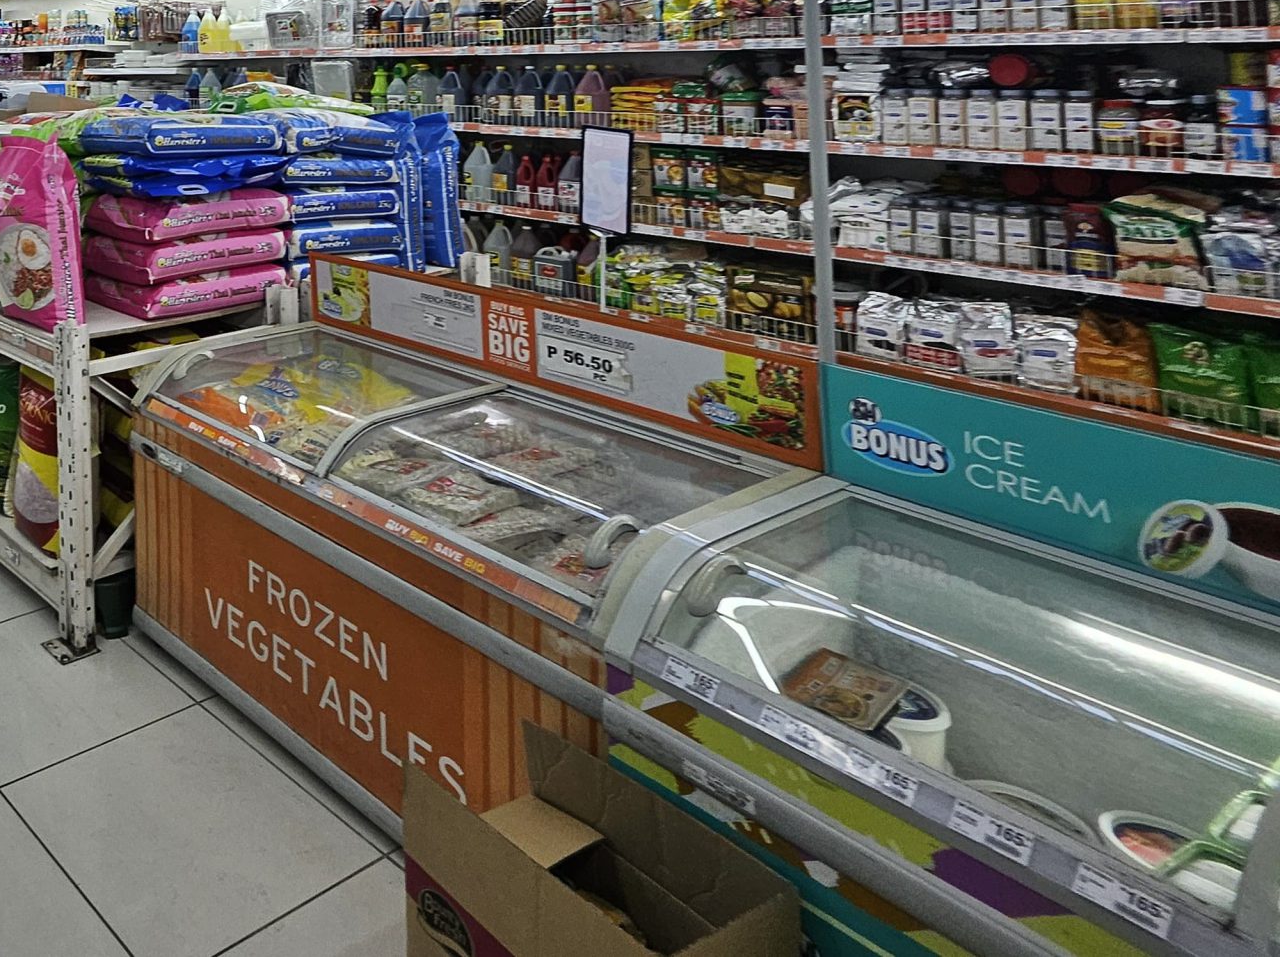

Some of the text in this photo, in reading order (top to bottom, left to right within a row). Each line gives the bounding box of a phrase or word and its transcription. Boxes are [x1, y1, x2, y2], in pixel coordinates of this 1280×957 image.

[488, 313, 529, 337] SAVE
[489, 329, 530, 362] BIG
[547, 345, 613, 373] P 56.50
[850, 423, 948, 473] BONUS
[963, 430, 1025, 468] ICE
[964, 463, 1112, 523] CREAM
[385, 519, 408, 536] BUY
[433, 542, 464, 563] SAVE
[464, 557, 486, 575] BIG
[248, 560, 388, 681] FROZEN
[204, 587, 468, 805] VEGETABLES
